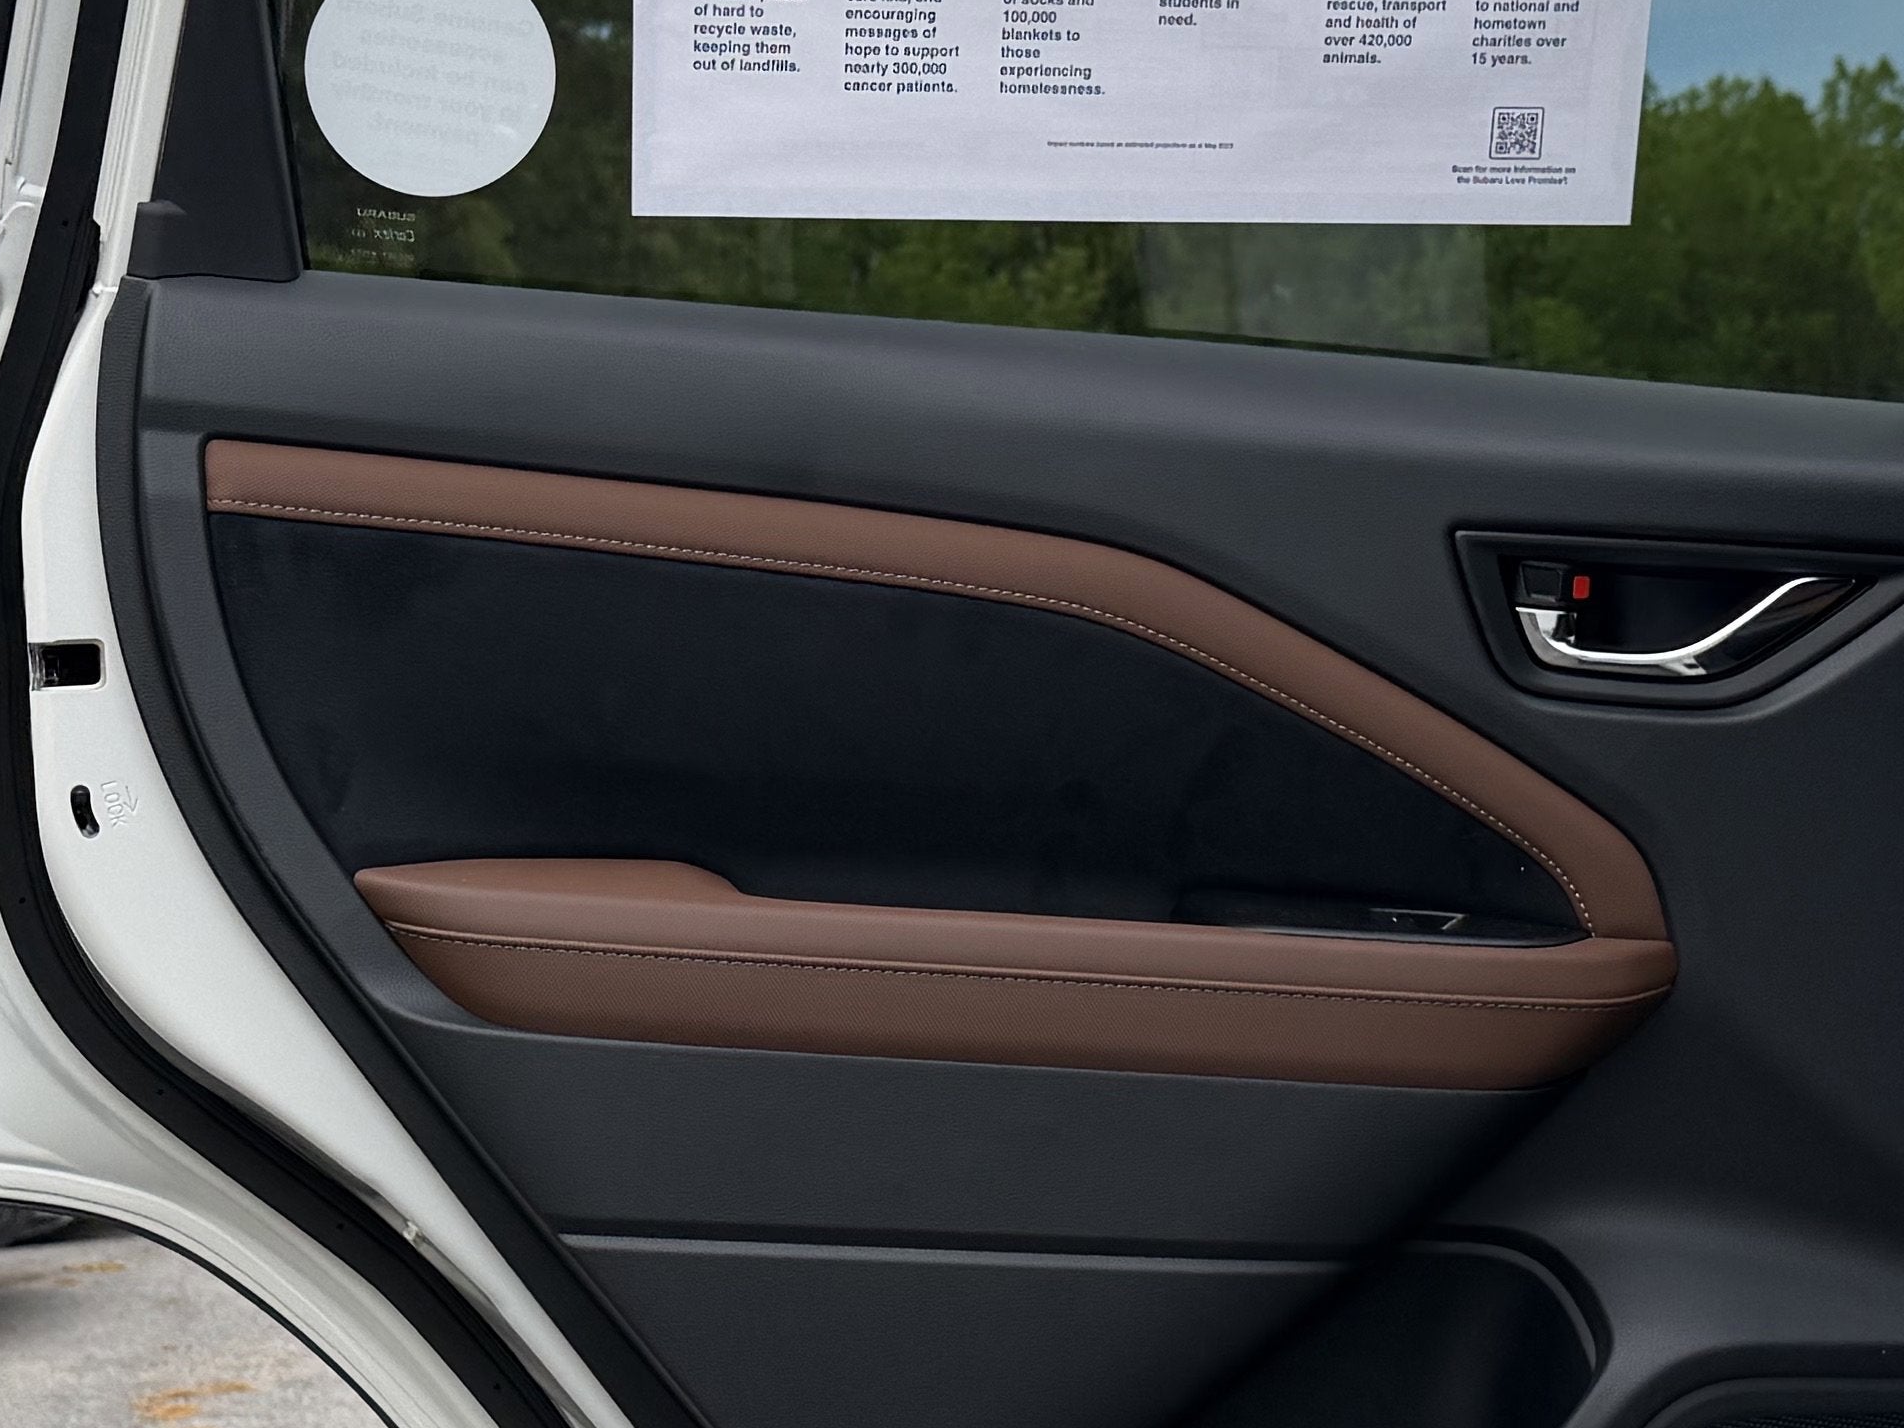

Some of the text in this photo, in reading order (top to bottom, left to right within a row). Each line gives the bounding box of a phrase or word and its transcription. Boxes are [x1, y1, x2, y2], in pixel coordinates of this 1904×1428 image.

[694, 4, 763, 17] of hard to
[1327, 0, 1446, 13] rescue, transport
[1476, 0, 1579, 11] to national and
[845, 8, 935, 23] encouraging
[1003, 10, 1056, 24] 100,000
[1158, 14, 1196, 25] need.
[1325, 16, 1416, 28] and health of
[694, 23, 795, 37] recycle waste,
[1474, 18, 1545, 29] hometown
[845, 27, 936, 40] messages of
[1002, 28, 1079, 41] blankets to
[1324, 34, 1411, 47] over 420,000
[1472, 36, 1566, 46] charities over
[693, 40, 790, 56] keeping them
[845, 43, 958, 59] hope to support
[1001, 46, 1040, 58] those
[1323, 52, 1380, 63] animals.
[1472, 52, 1531, 67] 15 years.
[693, 59, 799, 71] out of landfills.
[844, 61, 946, 76] nearly 300,000
[1000, 65, 1091, 80] experiencing
[844, 81, 957, 94] cancer patients.
[1000, 82, 1104, 94] homelessness.
[101, 780, 127, 828] LOCK
